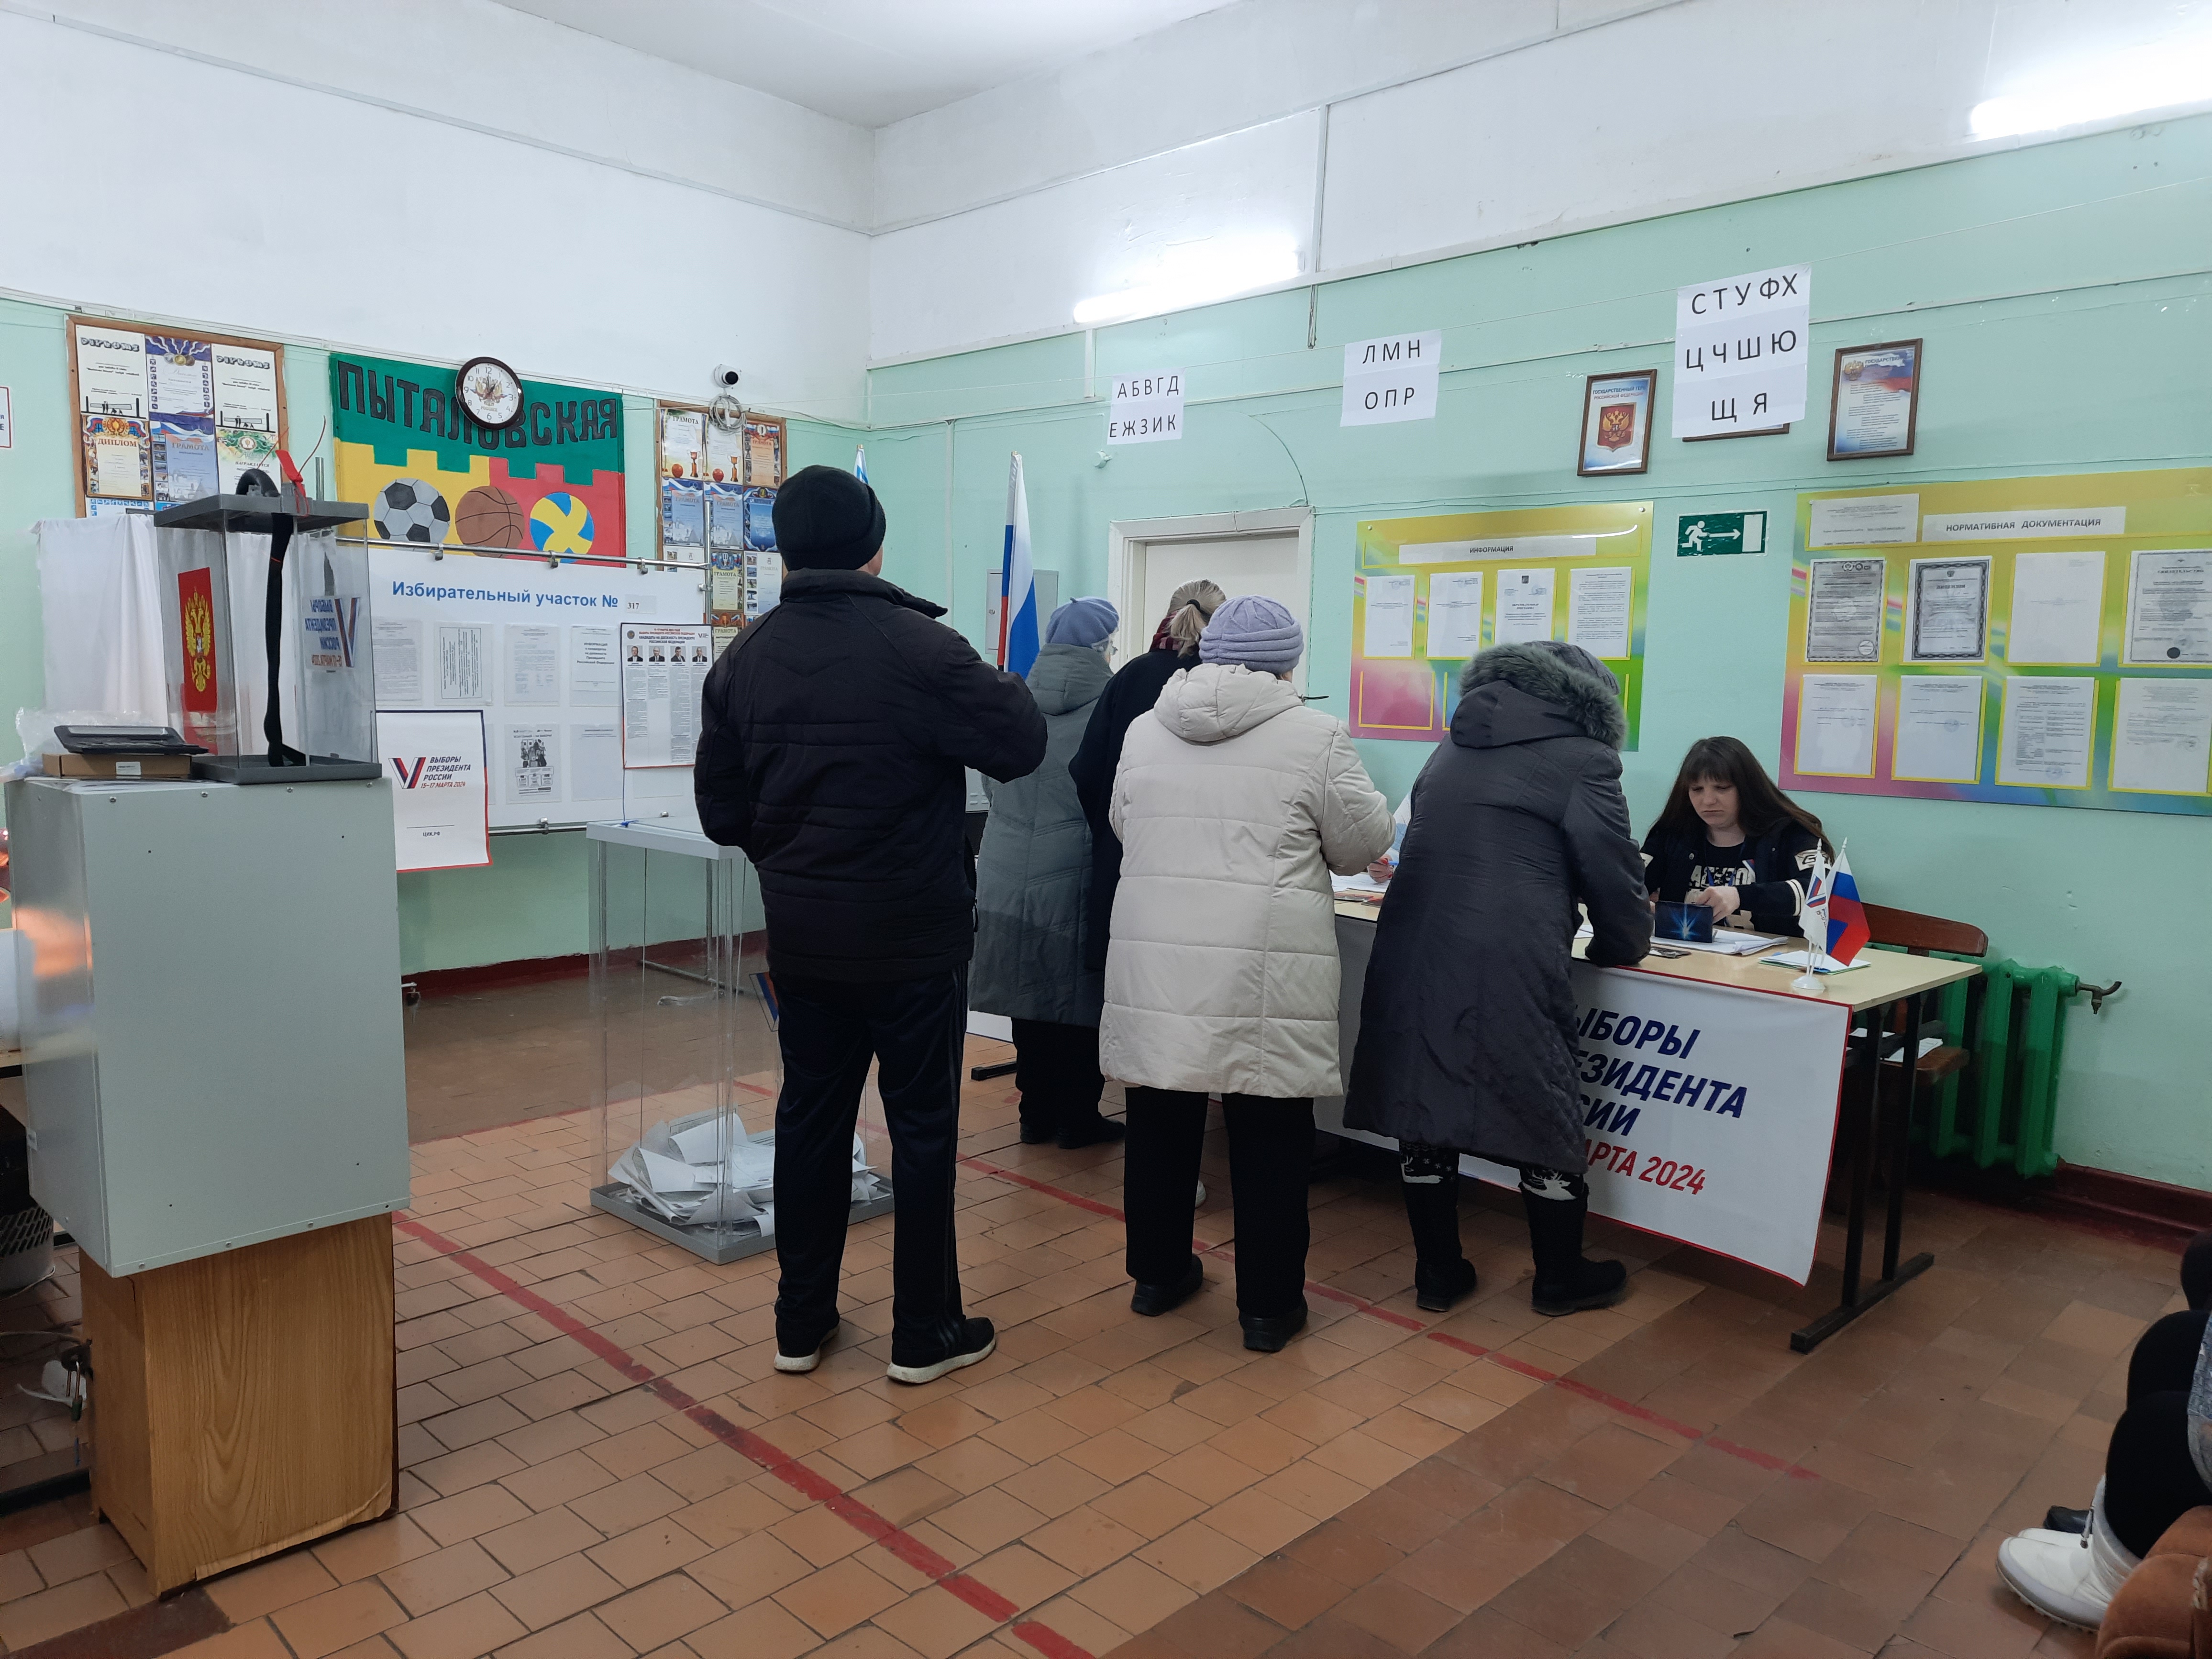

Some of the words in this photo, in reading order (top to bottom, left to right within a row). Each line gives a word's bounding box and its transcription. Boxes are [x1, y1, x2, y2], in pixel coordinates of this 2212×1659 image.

[673, 416, 699, 425] ГРАМОТА
[98, 438, 137, 447] ДИПЛОМ
[172, 442, 210, 451] ГРАМОТА
[1946, 521, 2015, 531] НОРМАТИВНАЯ
[2021, 519, 2101, 529] ДОКУМЕНТАЦИЯ
[1470, 545, 1514, 554] ИНФОРМАЦИЯ
[393, 581, 530, 603] Избирательный
[536, 591, 597, 608] участок
[602, 595, 619, 608] №
[627, 602, 639, 610] 317
[426, 764, 471, 773] ПРЕЗИДЕНТА
[1576, 1006, 1701, 1060] ЫБОРЫ
[1638, 1156, 1705, 1195] 2024
